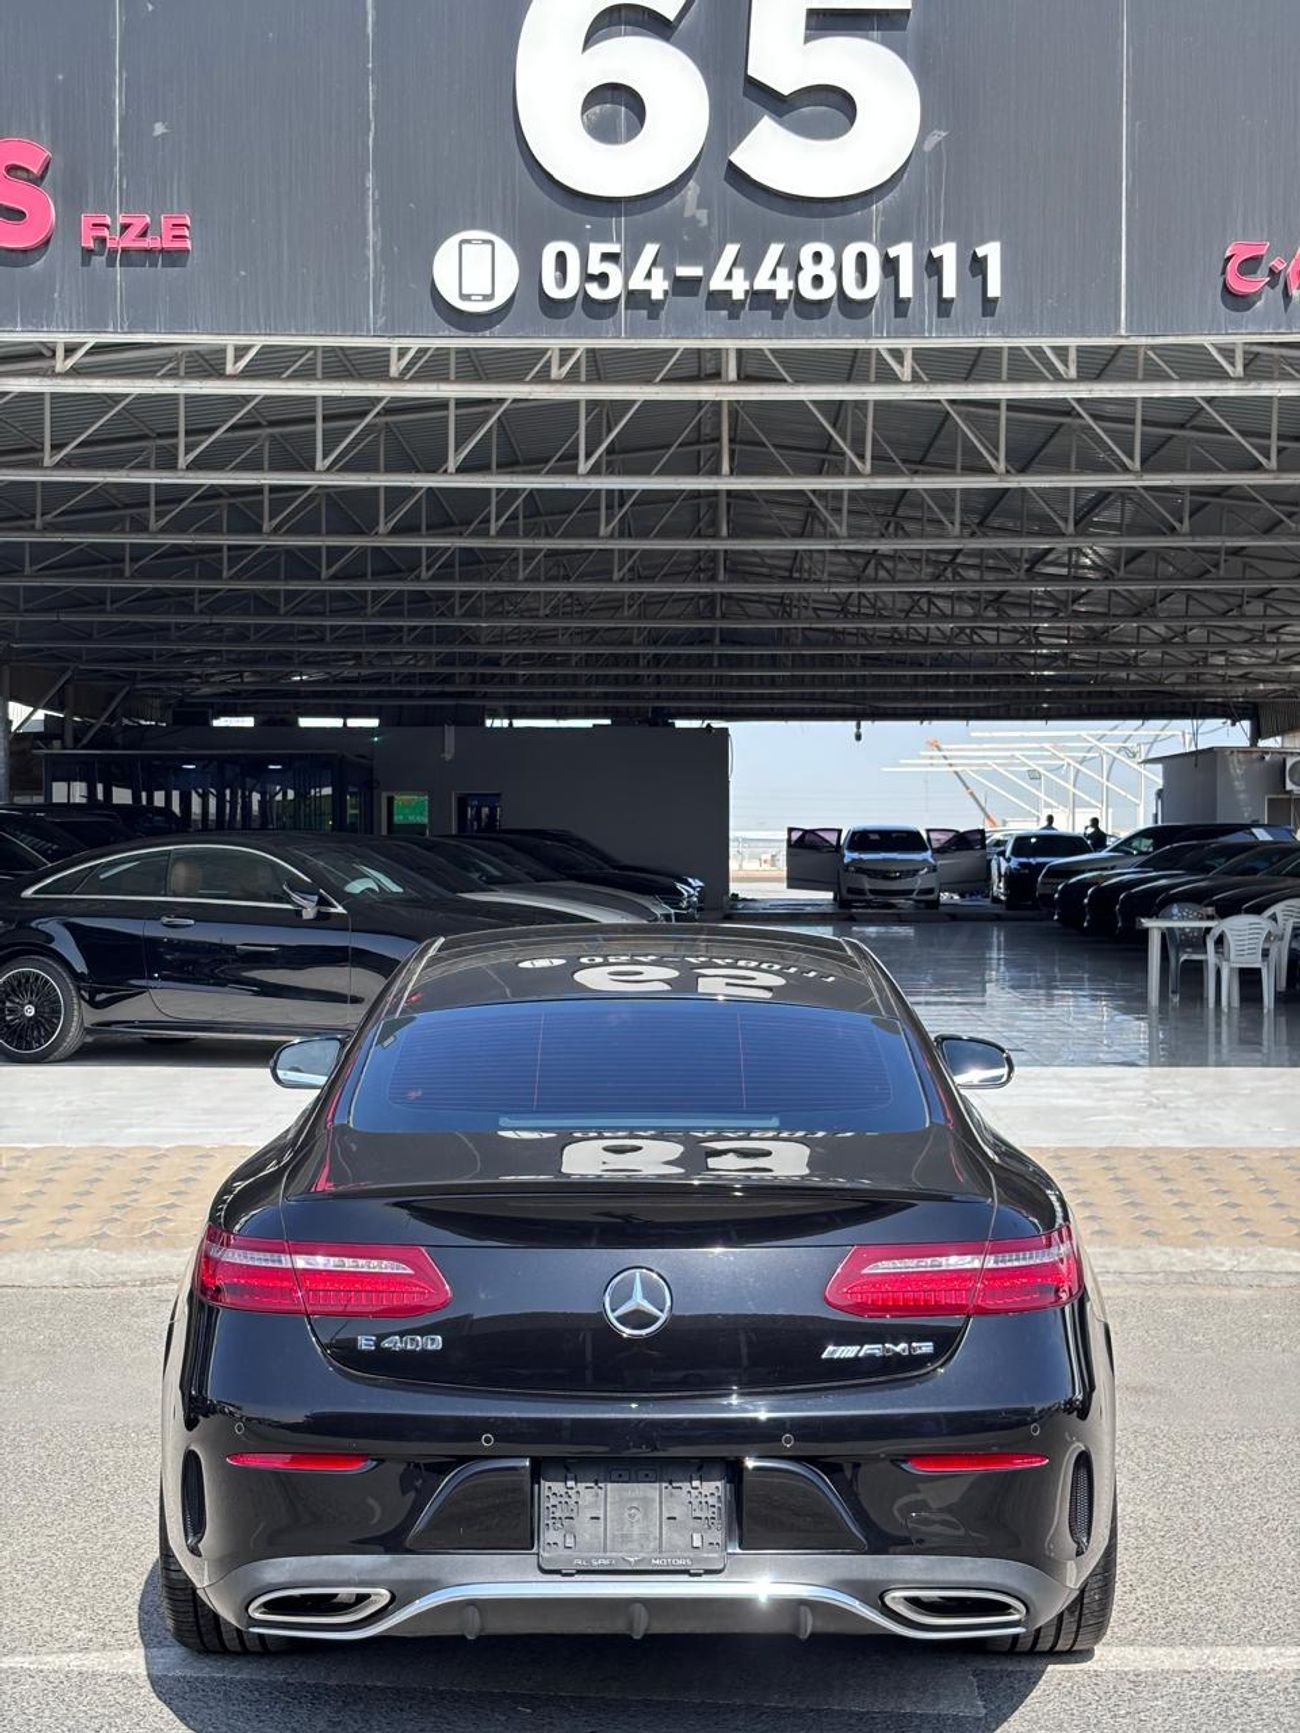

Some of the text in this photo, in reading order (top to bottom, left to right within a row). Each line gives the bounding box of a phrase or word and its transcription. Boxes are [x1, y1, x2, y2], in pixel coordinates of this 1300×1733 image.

[515, 0, 921, 198] 65
[81, 213, 192, 251] F.Z.E
[541, 240, 1001, 300] 054-4480111
[357, 1335, 443, 1351] E 400
[858, 1341, 934, 1357] AMG
[651, 1557, 693, 1567] MOTORS
